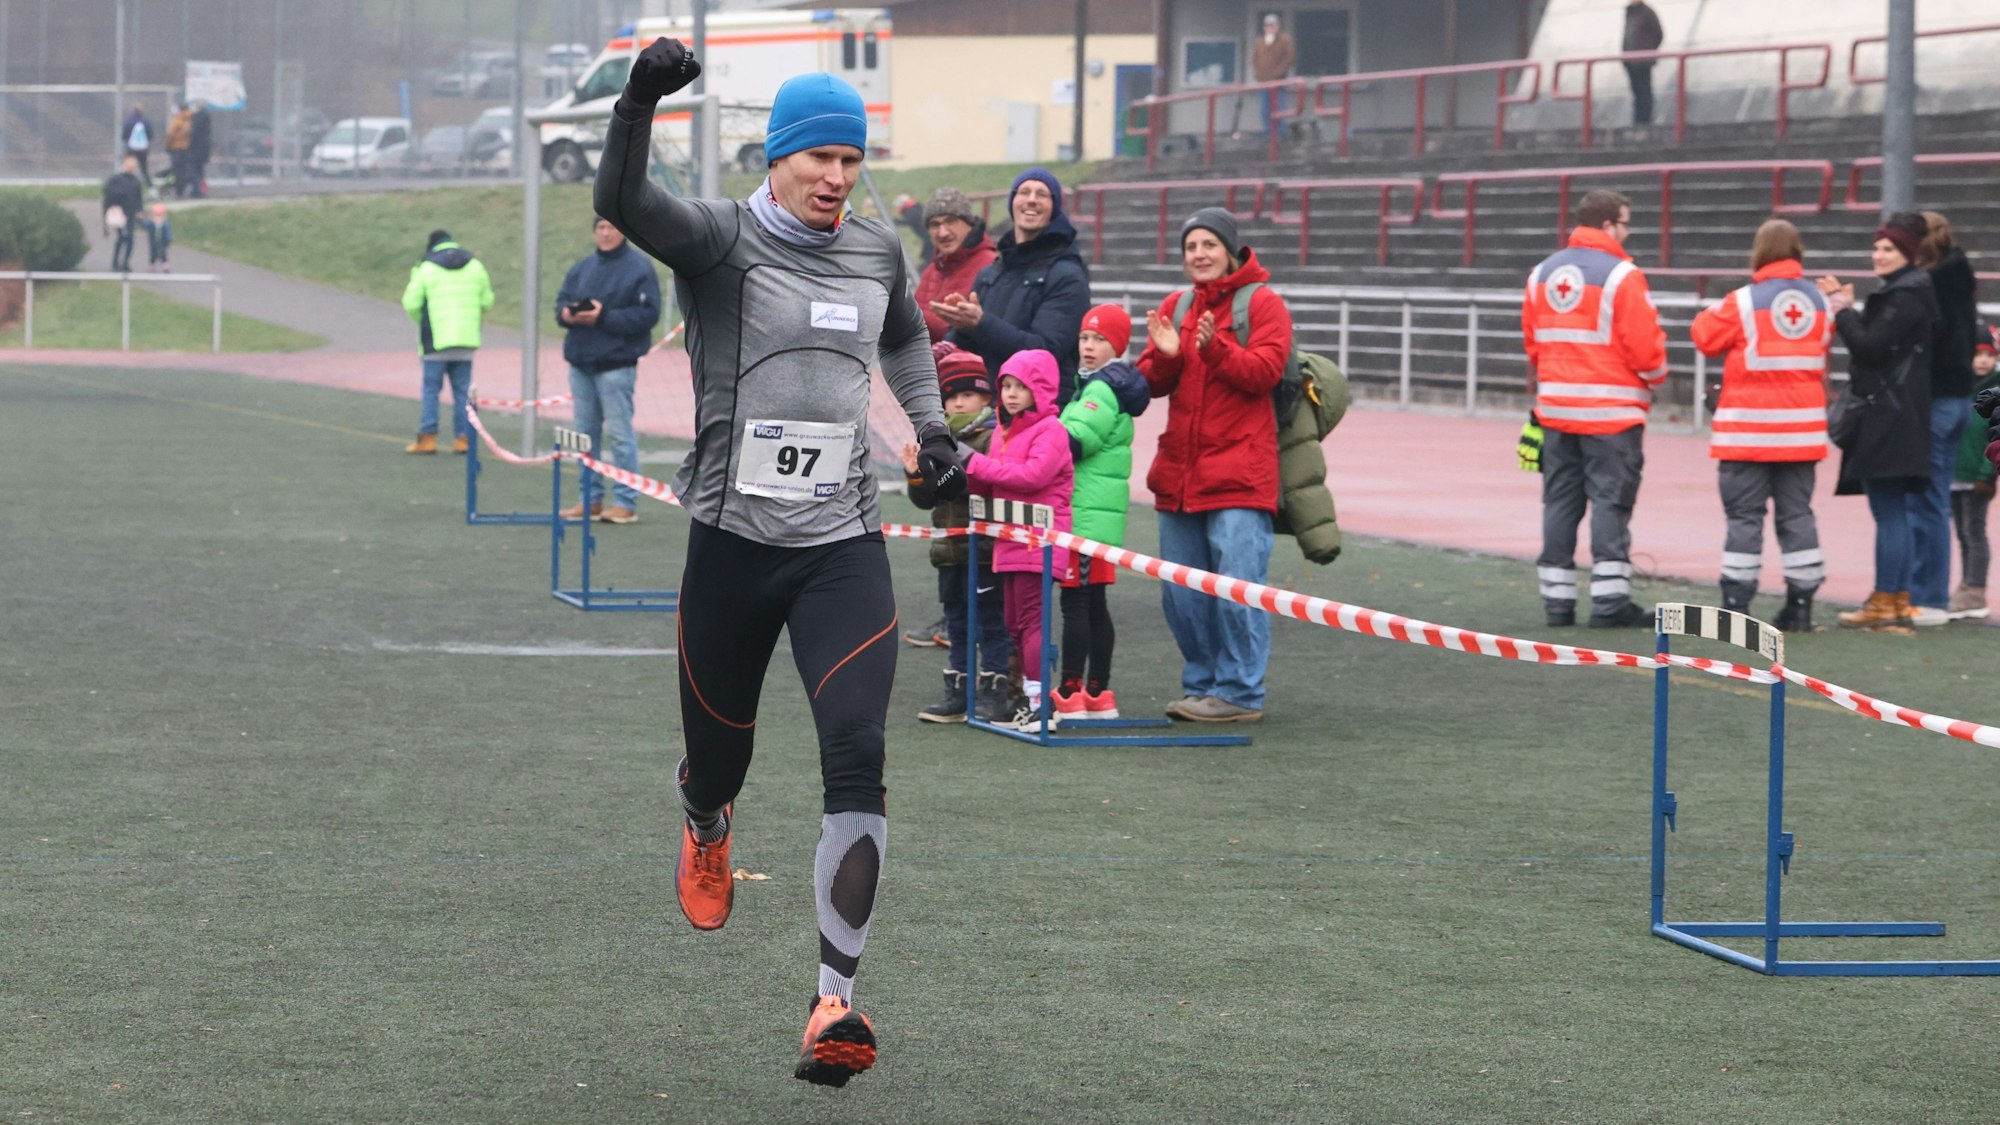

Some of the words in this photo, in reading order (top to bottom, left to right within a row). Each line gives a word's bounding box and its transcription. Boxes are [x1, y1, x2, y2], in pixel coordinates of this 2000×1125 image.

[756, 426, 781, 438] WGU
[776, 445, 821, 478] 97
[815, 483, 839, 496] WGU
